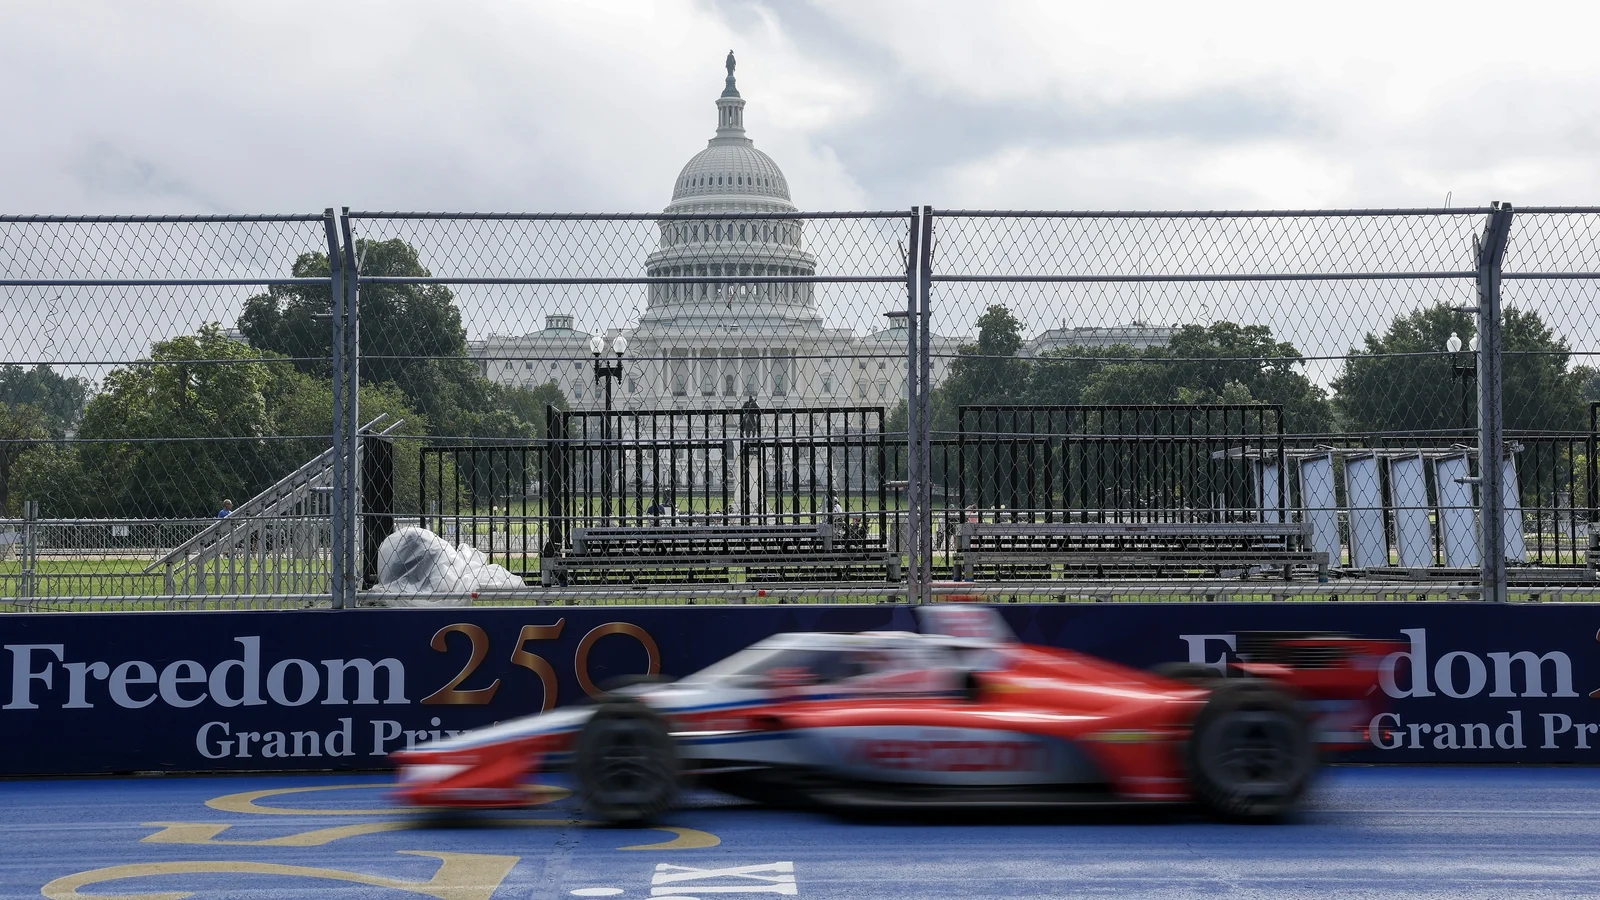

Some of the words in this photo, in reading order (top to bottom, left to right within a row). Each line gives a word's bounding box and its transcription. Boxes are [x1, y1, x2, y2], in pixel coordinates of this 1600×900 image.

[2, 636, 411, 709] Freedom
[420, 617, 661, 717] 250
[1179, 628, 1580, 699] Fdom
[196, 717, 356, 759] Grand
[1368, 710, 1527, 750] Grand
